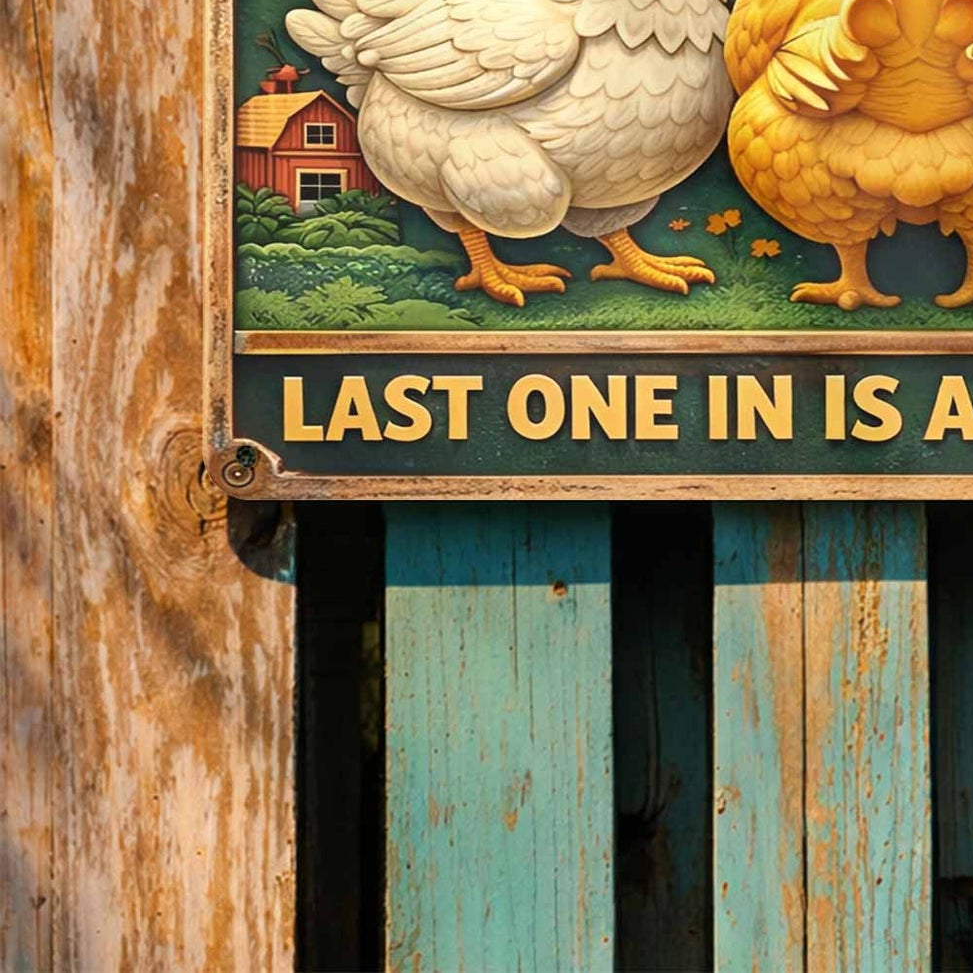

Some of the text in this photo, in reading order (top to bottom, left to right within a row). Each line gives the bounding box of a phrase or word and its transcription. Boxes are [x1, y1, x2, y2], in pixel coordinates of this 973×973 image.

[282, 373, 485, 443] LAST
[506, 373, 680, 442] ONE
[707, 373, 794, 441] IN
[823, 373, 903, 443] IS
